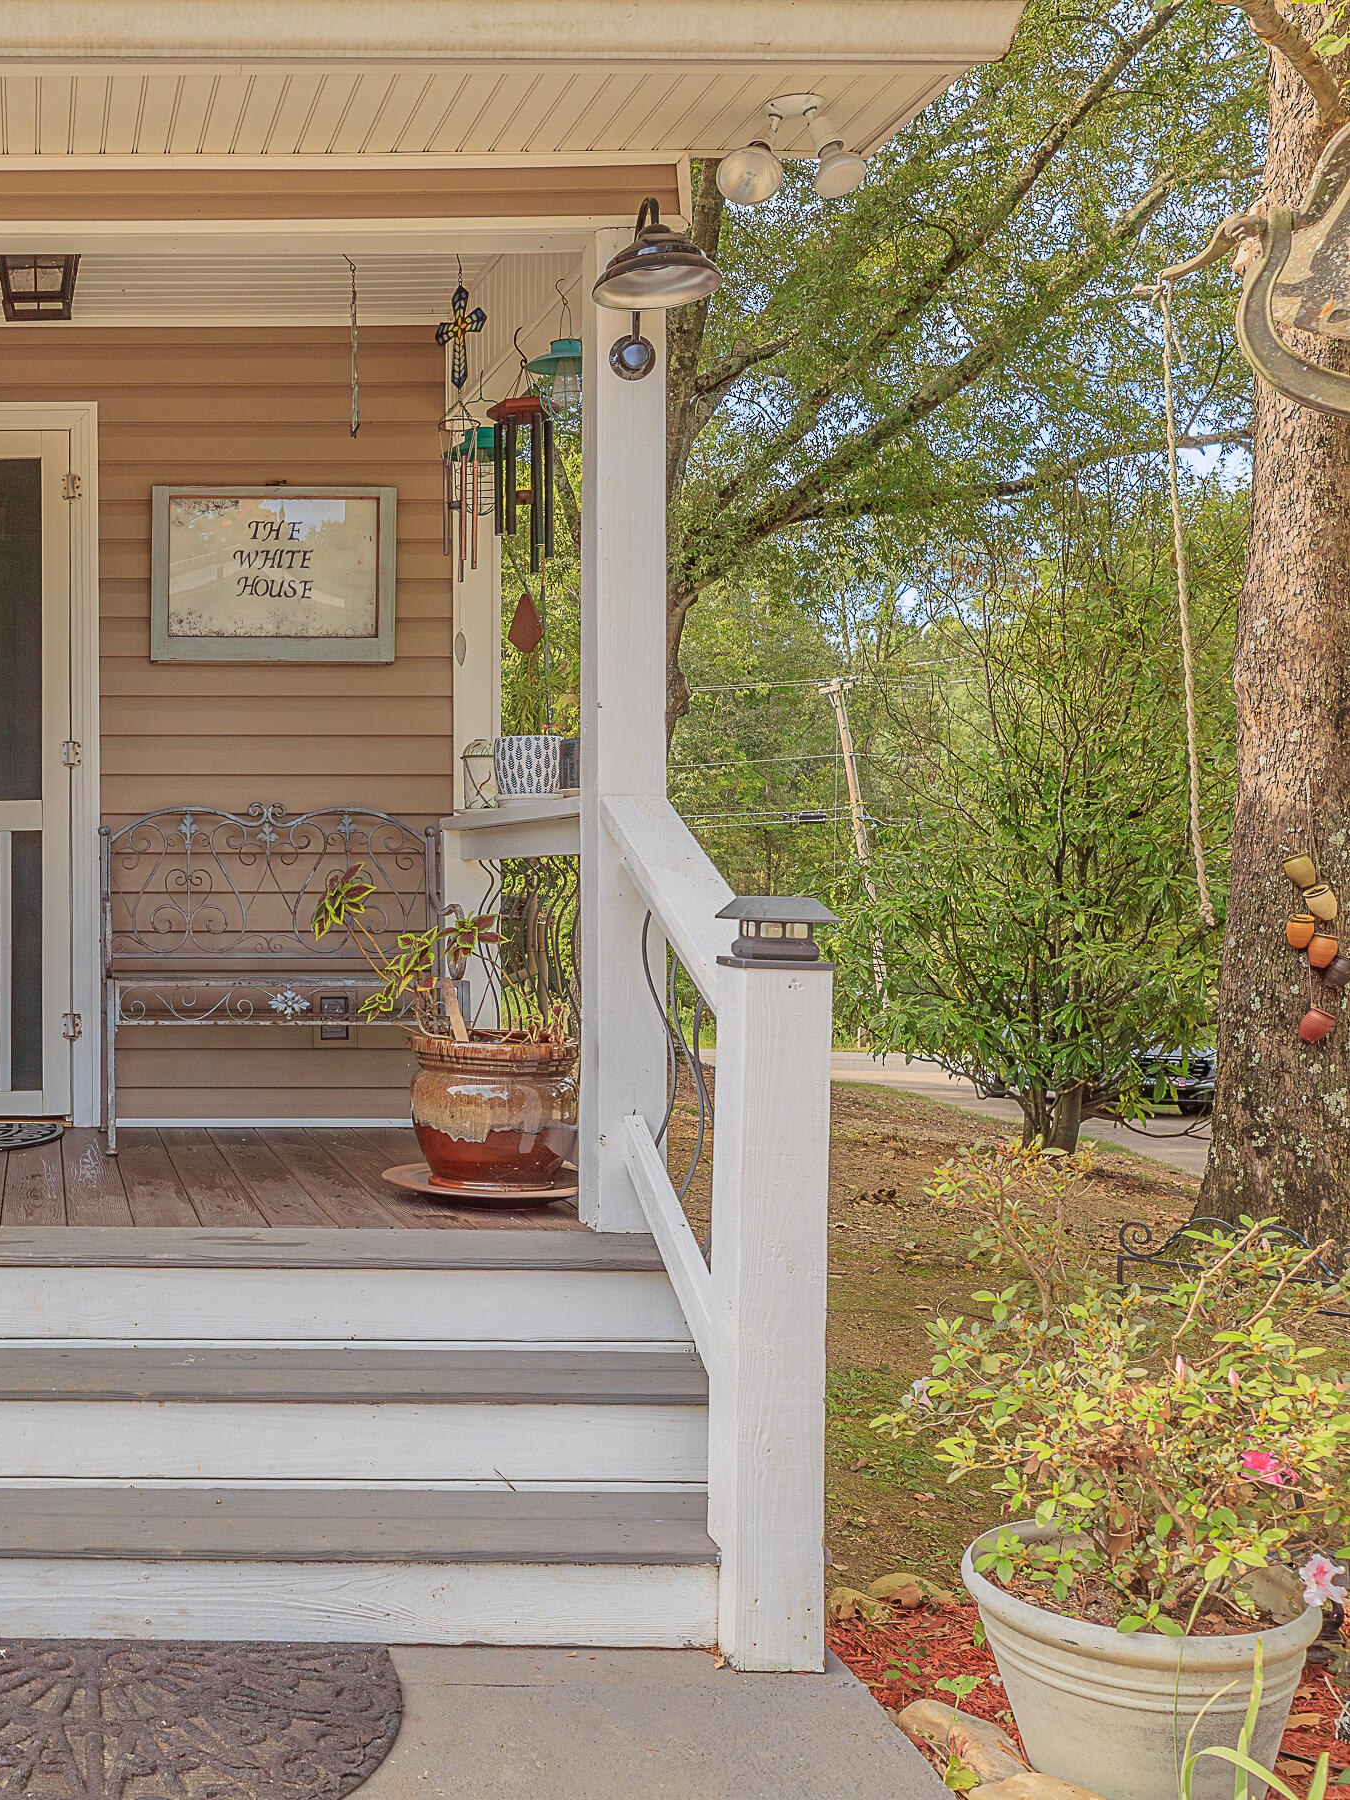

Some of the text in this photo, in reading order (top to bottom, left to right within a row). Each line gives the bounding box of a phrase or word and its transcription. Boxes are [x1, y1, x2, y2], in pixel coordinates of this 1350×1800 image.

[248, 520, 303, 541] THE
[233, 549, 314, 570] WHITE
[236, 575, 314, 599] HOUSE
